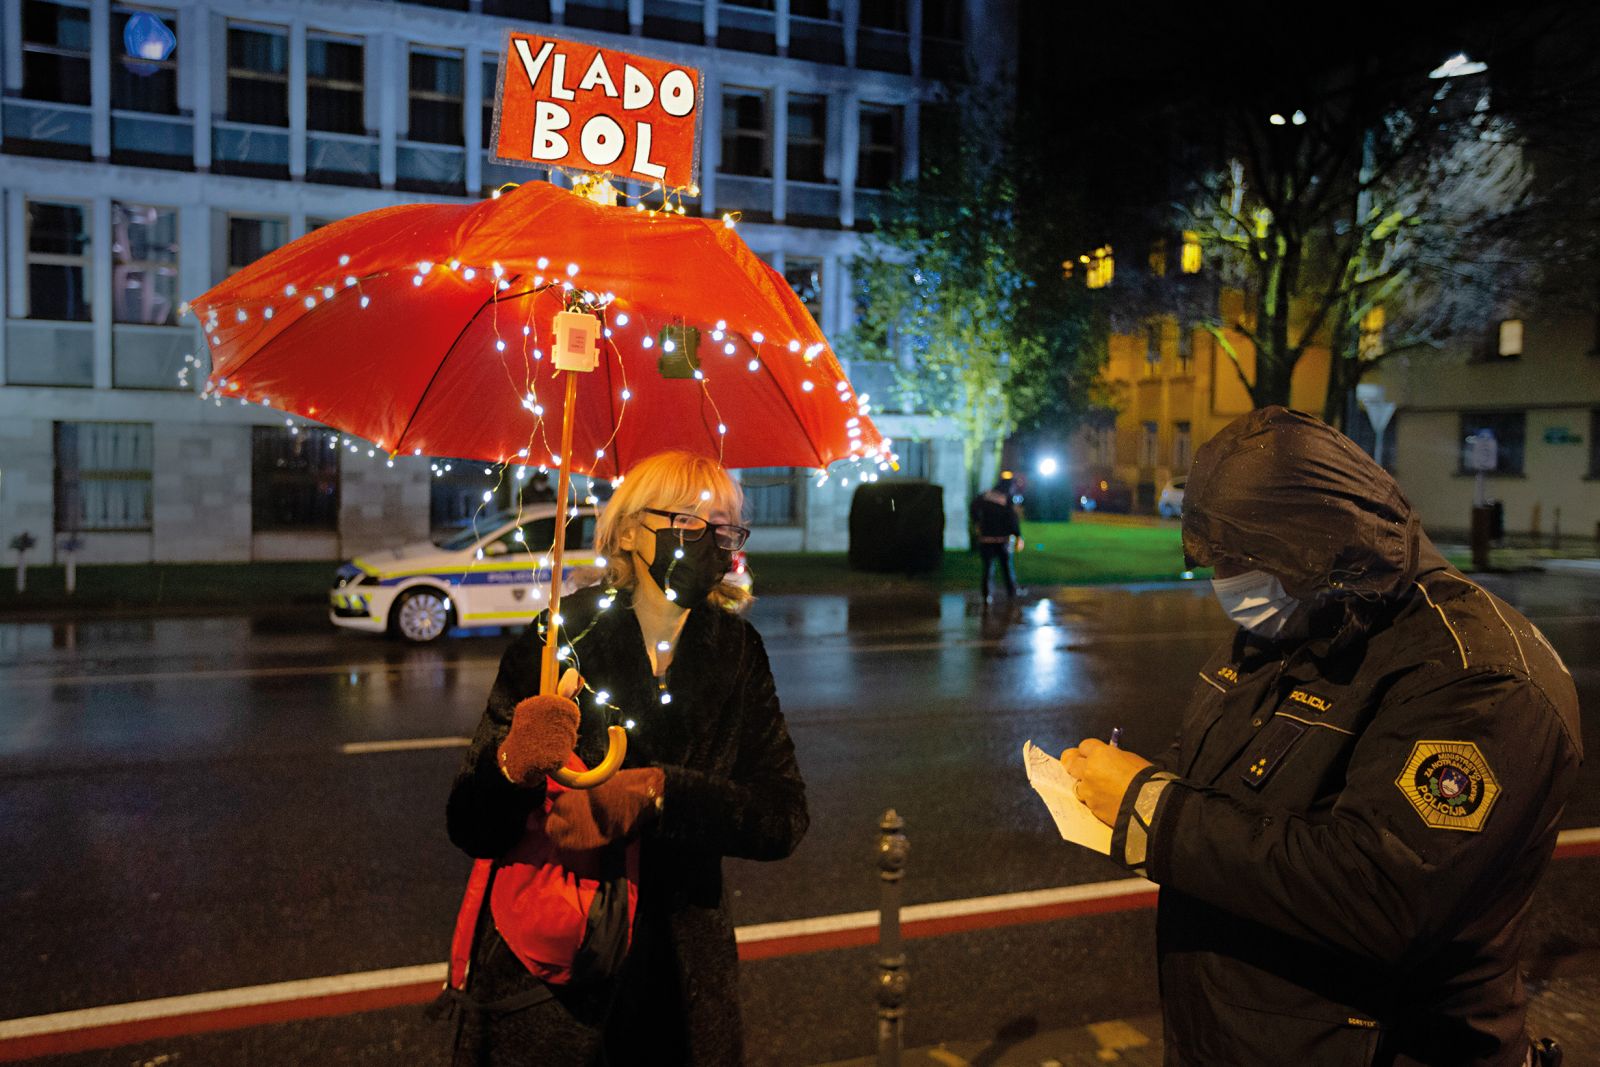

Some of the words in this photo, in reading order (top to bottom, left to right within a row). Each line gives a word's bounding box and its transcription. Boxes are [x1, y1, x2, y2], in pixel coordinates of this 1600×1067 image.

[512, 38, 695, 117] VLADO
[531, 100, 667, 180] BOL
[1424, 767, 1435, 778] ZA
[1418, 785, 1466, 815] POLICIJA
